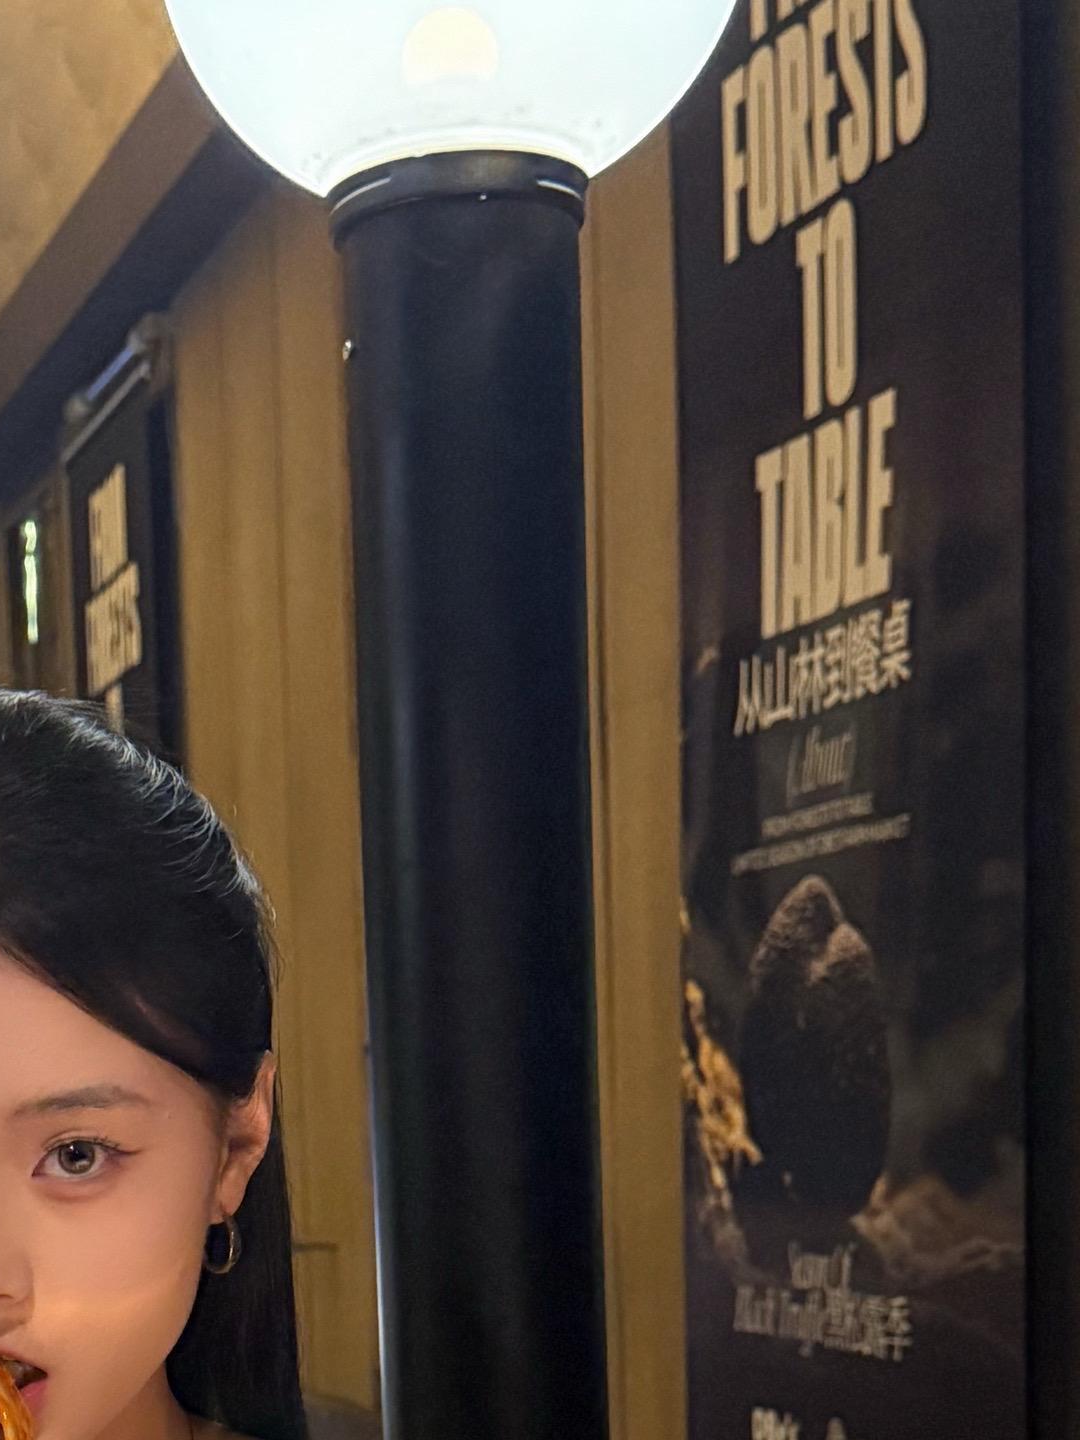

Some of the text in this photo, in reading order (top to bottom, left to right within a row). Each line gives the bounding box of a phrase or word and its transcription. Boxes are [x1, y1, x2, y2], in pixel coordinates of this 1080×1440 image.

[721, 0, 927, 263] FORESTS
[796, 198, 858, 420] TO
[755, 387, 897, 639] TABLE
